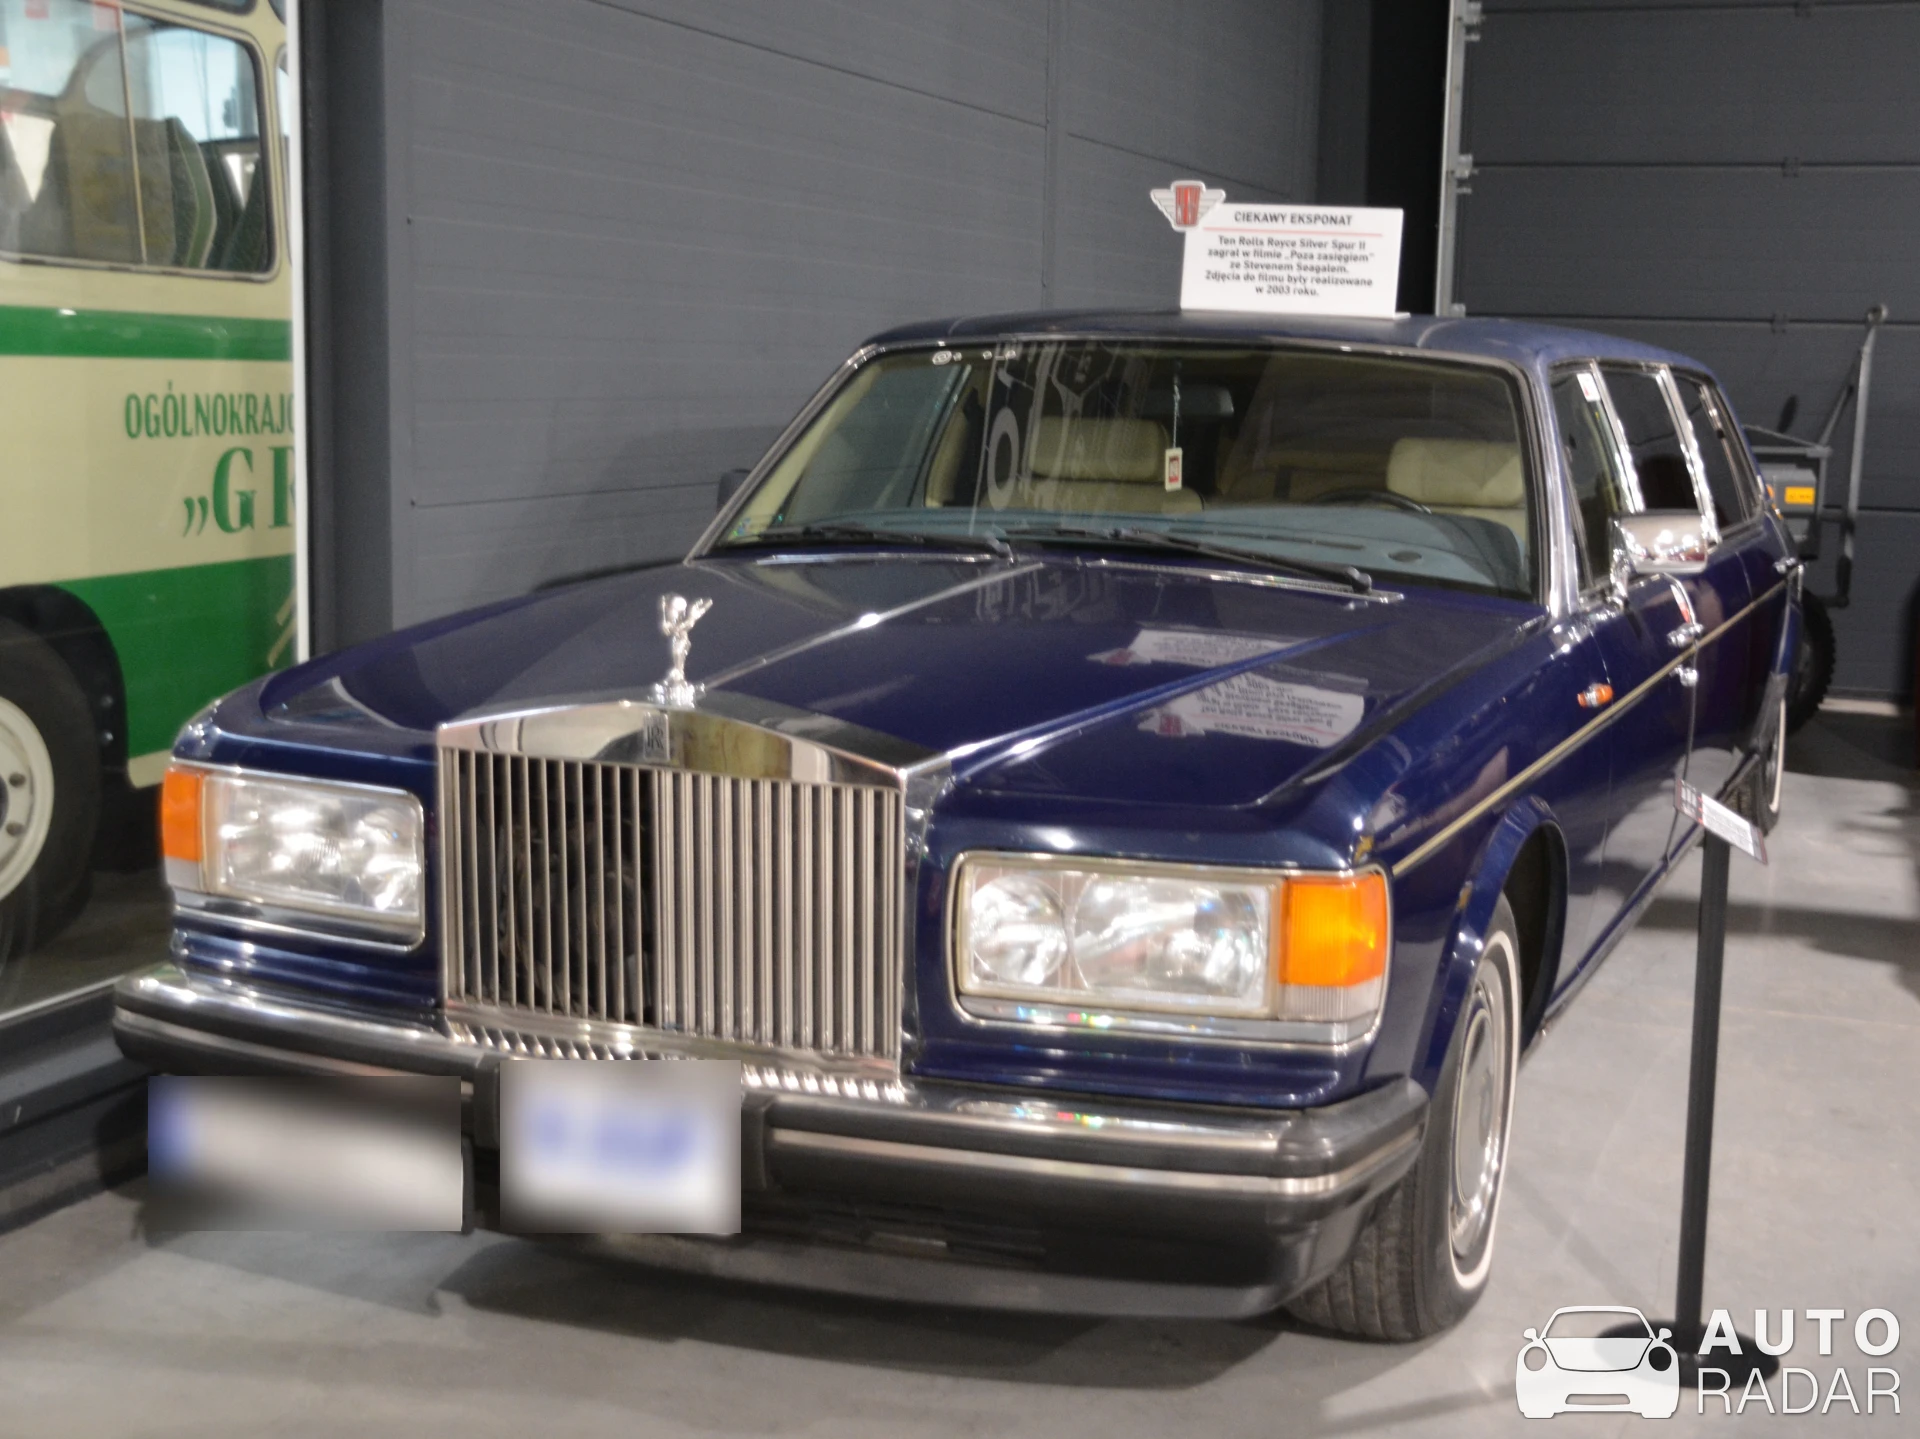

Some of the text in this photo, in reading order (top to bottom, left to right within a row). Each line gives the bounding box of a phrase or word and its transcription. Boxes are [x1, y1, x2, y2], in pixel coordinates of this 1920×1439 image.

[1234, 211, 1353, 226] CIEKAWY EKSPONAT
[1219, 235, 1236, 246] Ten
[1239, 236, 1264, 246] Rolls
[1267, 237, 1296, 248] Royce
[1300, 238, 1328, 249] Silver
[1332, 239, 1356, 251] Spur
[1208, 249, 1240, 260] zagrał
[1253, 249, 1282, 259] filmie
[1230, 260, 1350, 274] ze Stevenem Seagalem.
[1205, 270, 1373, 287] Zdjęcia do filmu były realizowane
[1255, 285, 1320, 297] w 2003 roku.
